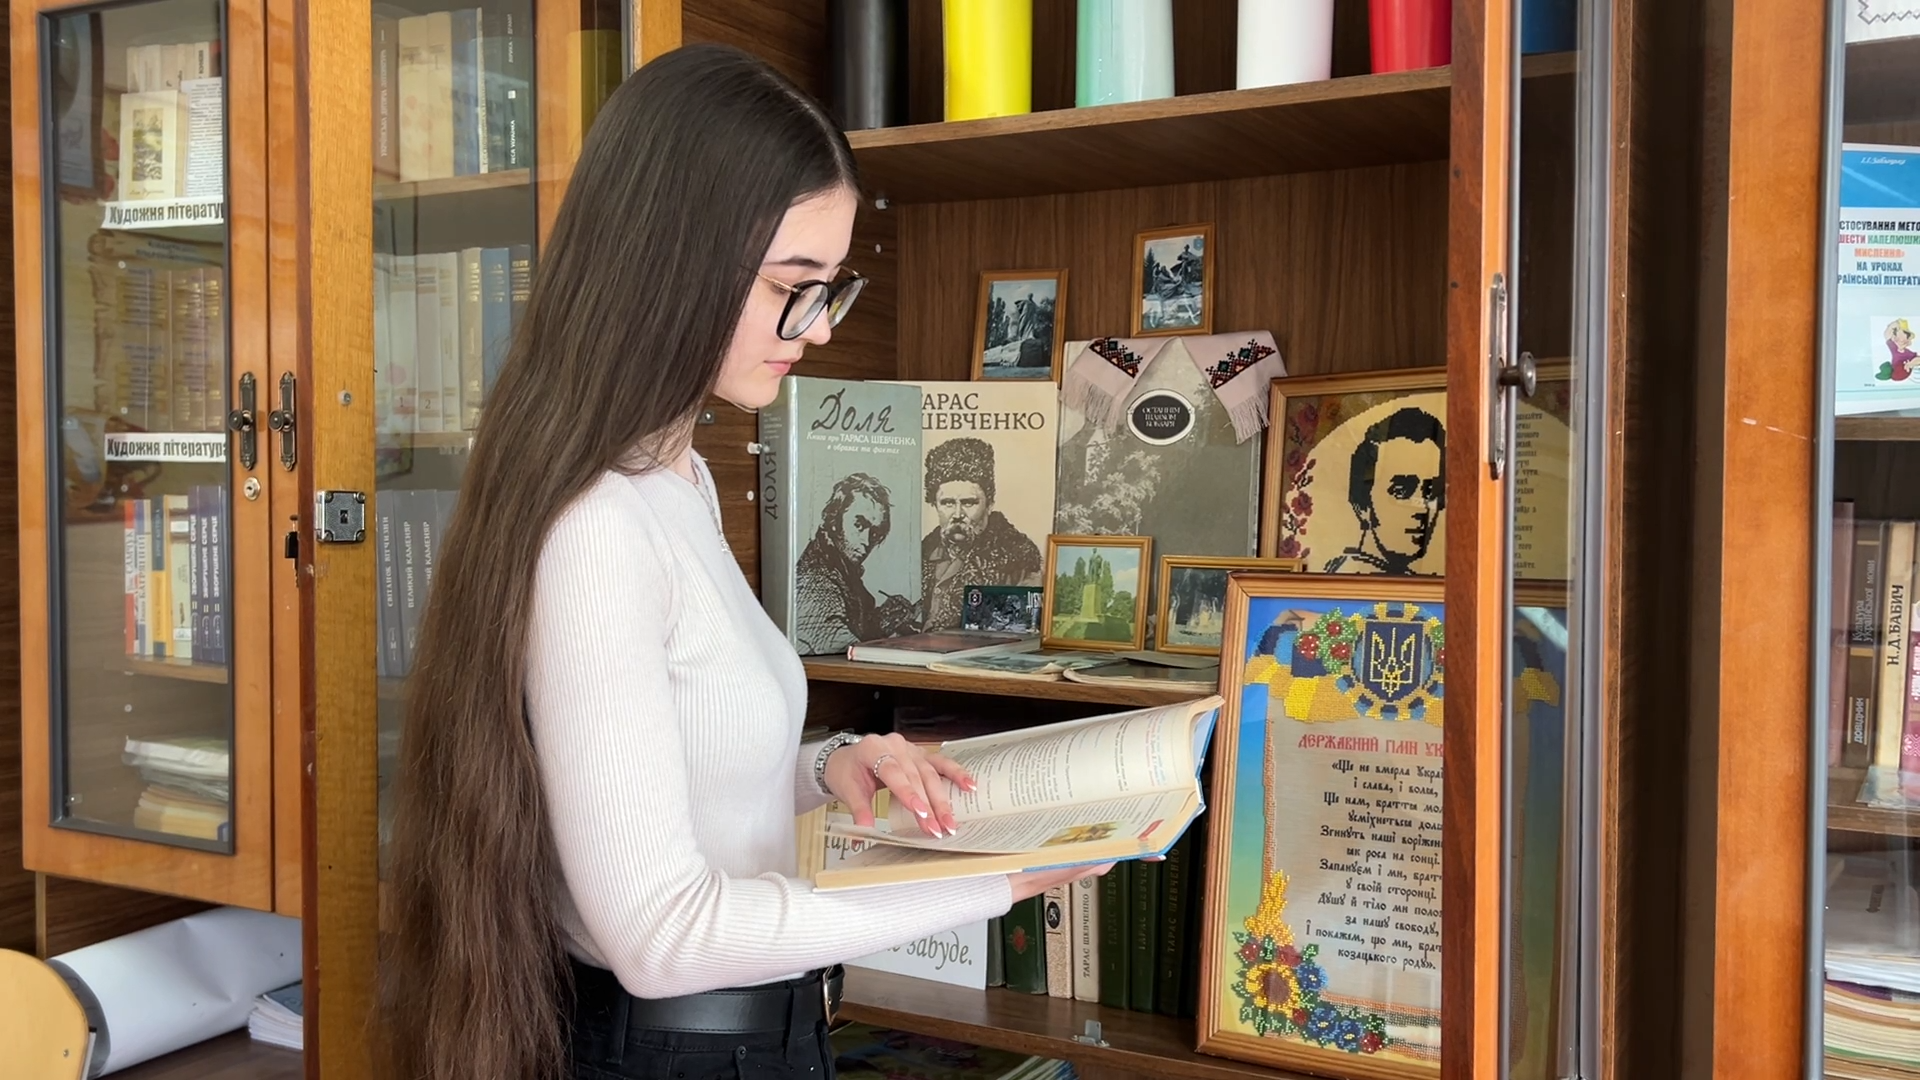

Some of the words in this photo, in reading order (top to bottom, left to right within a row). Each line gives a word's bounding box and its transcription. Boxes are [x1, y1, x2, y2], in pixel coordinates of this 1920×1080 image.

[109, 206, 165, 225] Художня
[1856, 261, 1868, 272] НА
[1870, 261, 1904, 273] УРОКАХ
[425, 398, 431, 410] 2
[811, 388, 895, 434] Доля
[921, 393, 979, 412] АРАС
[106, 438, 161, 457] Художня
[840, 433, 870, 444] ТАРАСА
[871, 435, 917, 447] ШЕВЧЕНКА
[763, 450, 779, 520] ДОЛЯ
[382, 516, 391, 562] ВІТЧИЗНИ
[404, 521, 413, 564] КАМЕНЯР
[423, 521, 432, 565] КАМЕНЯР
[385, 566, 394, 607] СВІТАНОК
[405, 567, 415, 608] ВЕЛИКИЙ
[1886, 584, 1904, 666] Н.Д.БАБИЧ
[1853, 697, 1864, 743] ДОВІДНИК
[1298, 733, 1379, 752] ДЕРЖАВНИЙ
[1386, 739, 1418, 755] ГІМН
[1359, 764, 1370, 773] не
[1375, 766, 1411, 780] вмерла
[1353, 776, 1358, 788] і
[1362, 781, 1394, 794] слава,
[1399, 780, 1403, 792] і
[1408, 785, 1439, 798] воля,
[1323, 792, 1340, 806] Ще
[1345, 796, 1371, 809] нам,
[1376, 799, 1418, 813] браття
[1320, 825, 1366, 840] Згинуть
[1371, 830, 1397, 844] наші
[1346, 847, 1361, 857] як
[1365, 850, 1388, 863] роса
[1392, 852, 1405, 862] на
[1411, 853, 1441, 869] сонці.
[1168, 848, 1180, 910] ШЕВЧЕНКО
[1319, 858, 1372, 875] Запануєм
[1377, 863, 1382, 876] і
[1386, 869, 1408, 881] ми,
[1318, 891, 1347, 906] Душу
[1362, 897, 1387, 911] тіло
[1392, 904, 1408, 913] ми
[1357, 881, 1382, 894] своїй
[1387, 886, 1437, 904] сторонці.
[1081, 893, 1092, 946] ШЕВЧЕНКО
[1345, 915, 1358, 925] за
[1362, 916, 1391, 929] нашу
[1395, 921, 1439, 937] свободу,
[1138, 917, 1147, 951] ТАРАС
[1167, 917, 1178, 953] ТАРАС
[1370, 936, 1387, 950] що
[1392, 939, 1412, 951] ми,
[1082, 948, 1092, 979] ТАРАС
[1338, 948, 1398, 965] козацького
